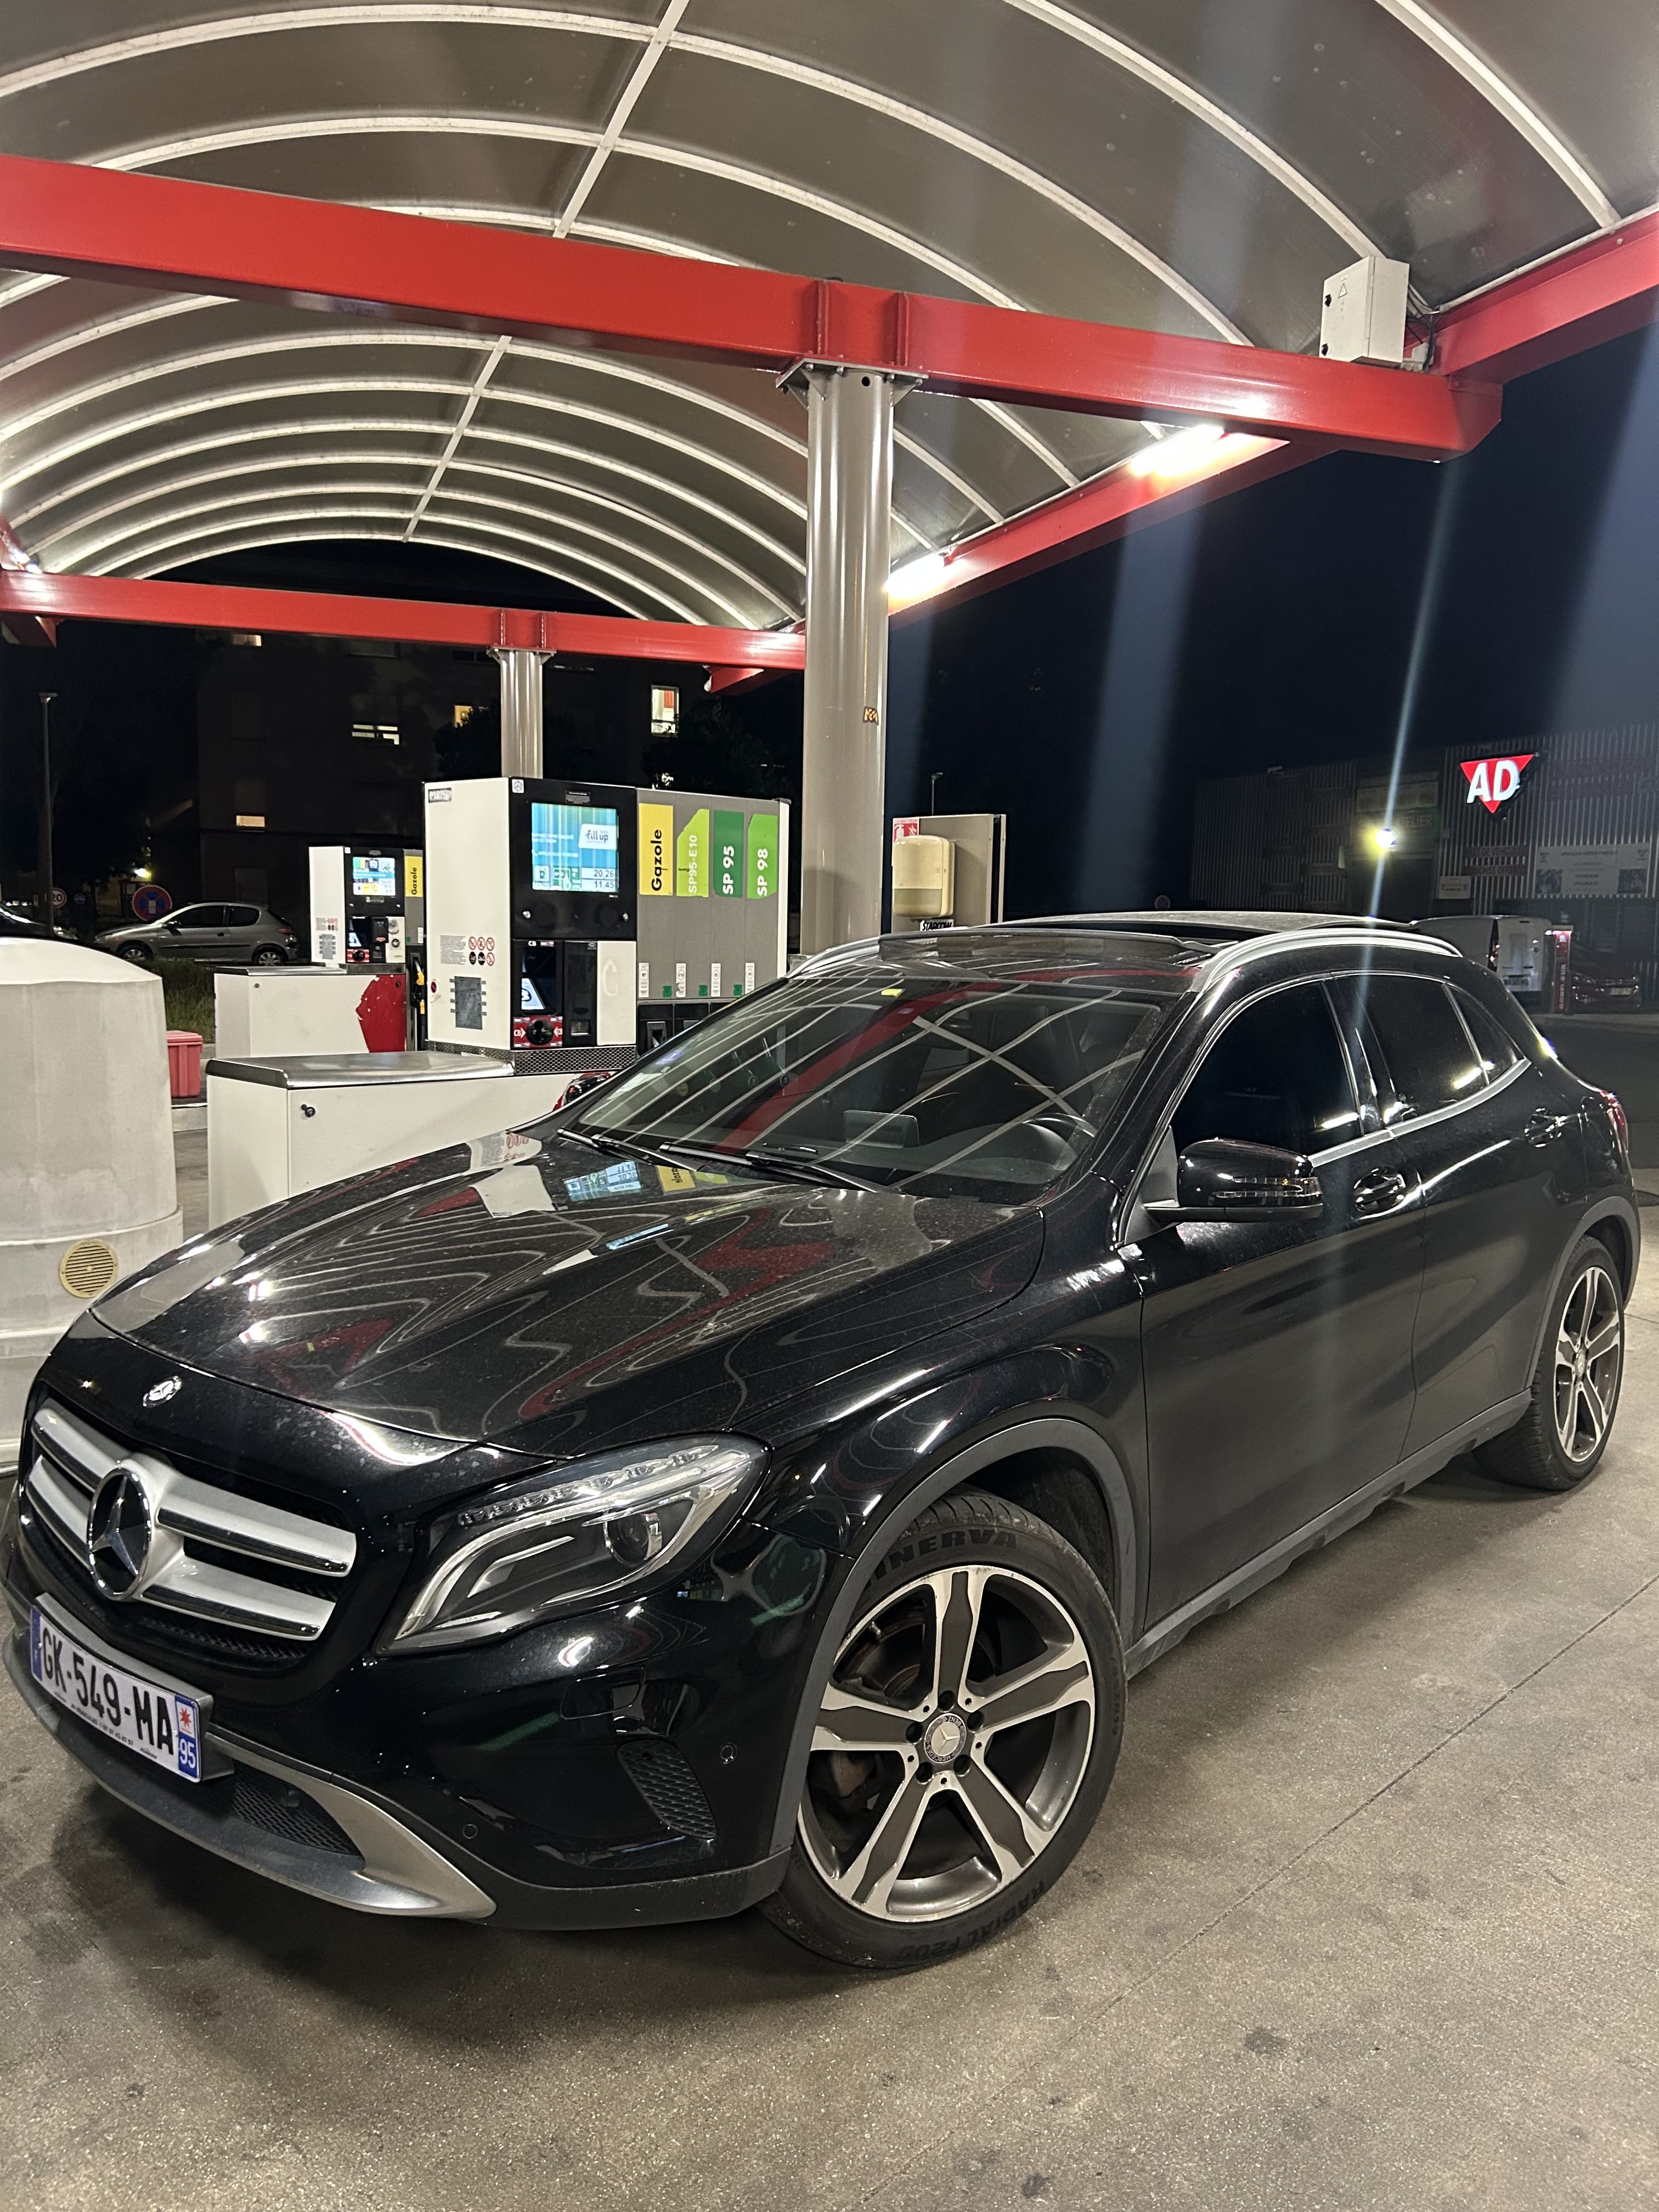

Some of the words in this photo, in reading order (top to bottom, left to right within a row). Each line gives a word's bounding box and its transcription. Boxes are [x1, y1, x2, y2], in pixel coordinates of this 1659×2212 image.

[1466, 759, 1521, 803] AD
[586, 830, 599, 840] fill
[599, 834, 608, 843] up
[650, 829, 662, 891] Gazole
[688, 834, 698, 894] SP95-E10
[723, 845, 735, 868] 95
[757, 848, 769, 871] 98
[594, 869, 614, 879] 20,26
[594, 881, 614, 889] 11,45
[722, 873, 734, 895] SP
[757, 875, 768, 896] SP
[867, 1529, 1017, 1583] INERVA
[42, 1627, 174, 1756] GK-549-MA
[947, 1716, 962, 1726] BENZ
[179, 1738, 196, 1769] 95
[926, 1744, 951, 1762] MERCEDES
